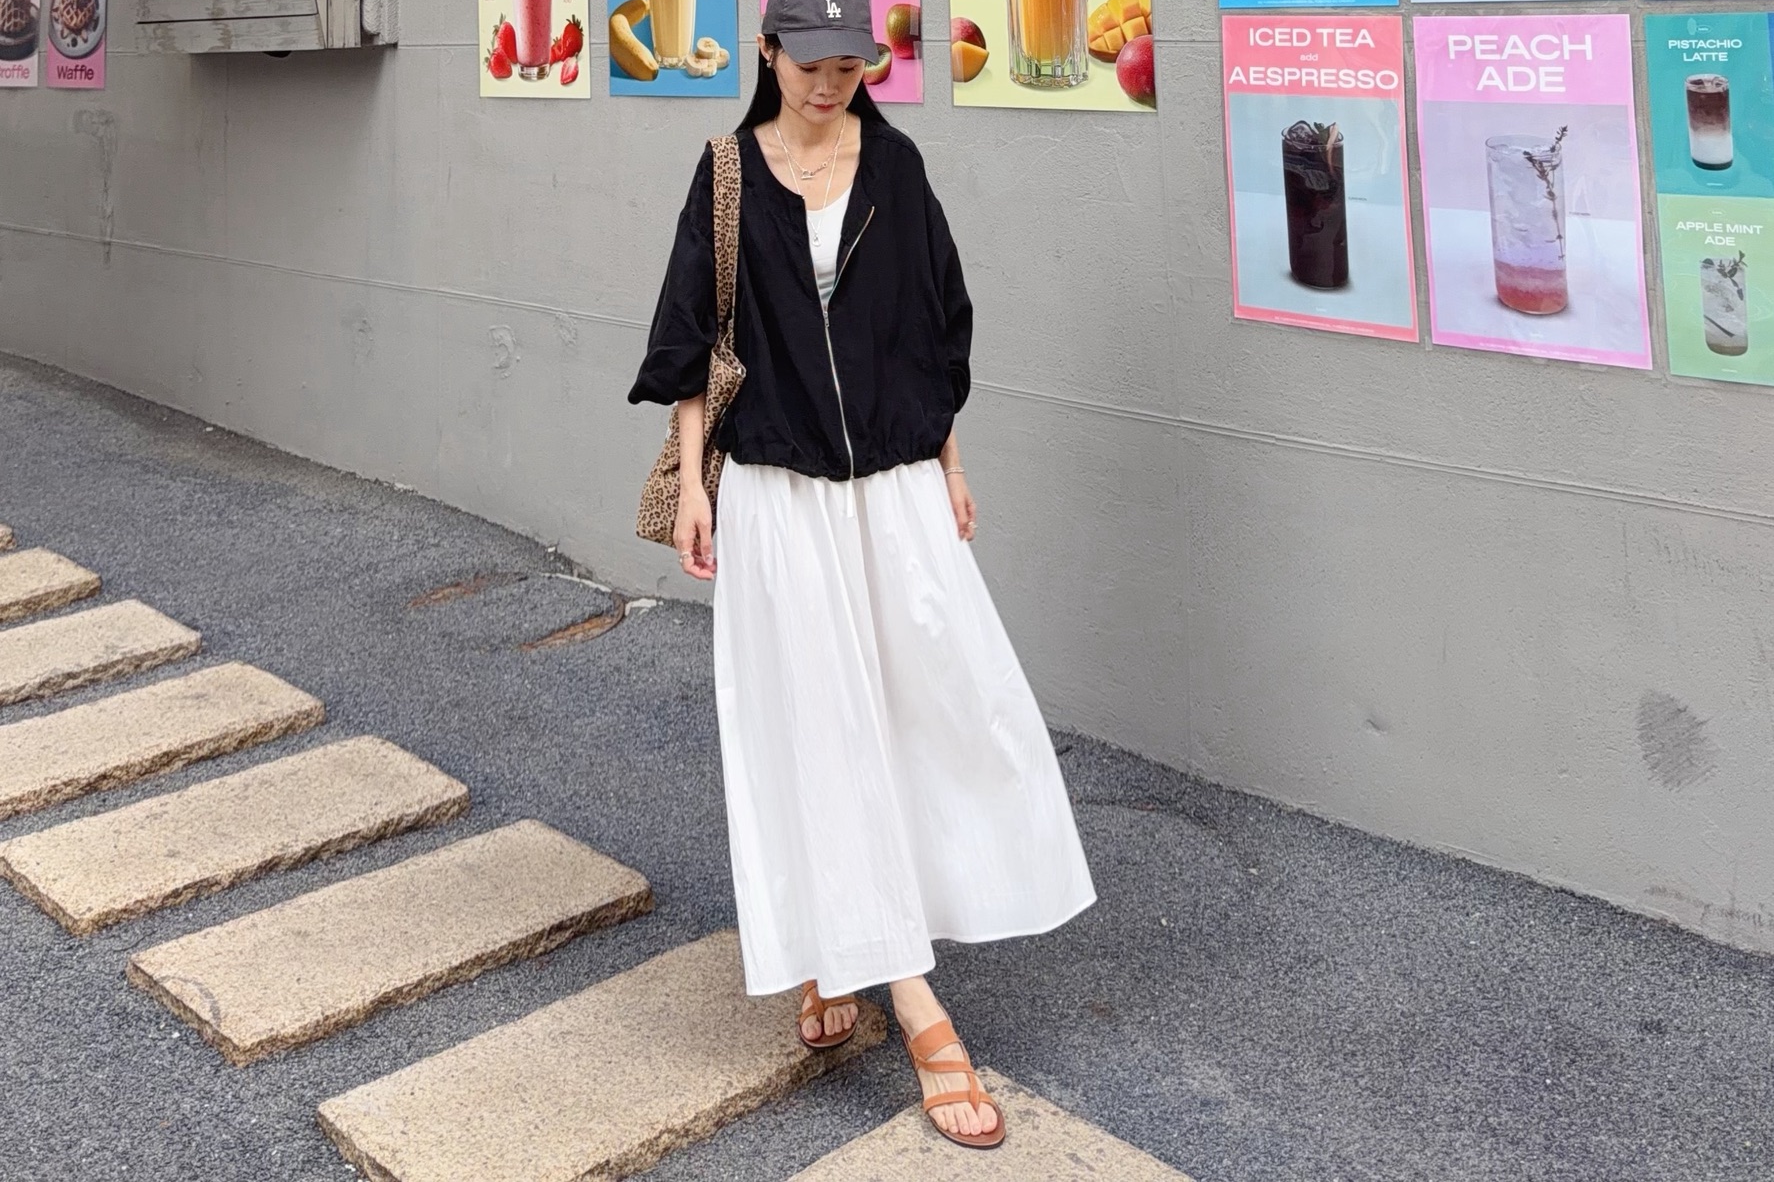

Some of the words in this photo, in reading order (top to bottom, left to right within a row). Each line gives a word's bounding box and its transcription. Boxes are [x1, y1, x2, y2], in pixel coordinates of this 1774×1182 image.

[1249, 27, 1311, 47] ICED
[1316, 28, 1376, 48] TEA
[1668, 39, 1743, 50] PISTACHIO
[1447, 33, 1593, 61] PEACH
[1299, 53, 1319, 62] add
[1683, 52, 1729, 62] LATTE
[57, 65, 95, 80] Waffle
[1228, 65, 1399, 90] AESPRESSO
[1476, 65, 1567, 93] ADE
[1675, 220, 1723, 234] APPLE
[1726, 223, 1764, 236] MINT
[1704, 235, 1736, 247] ADE
